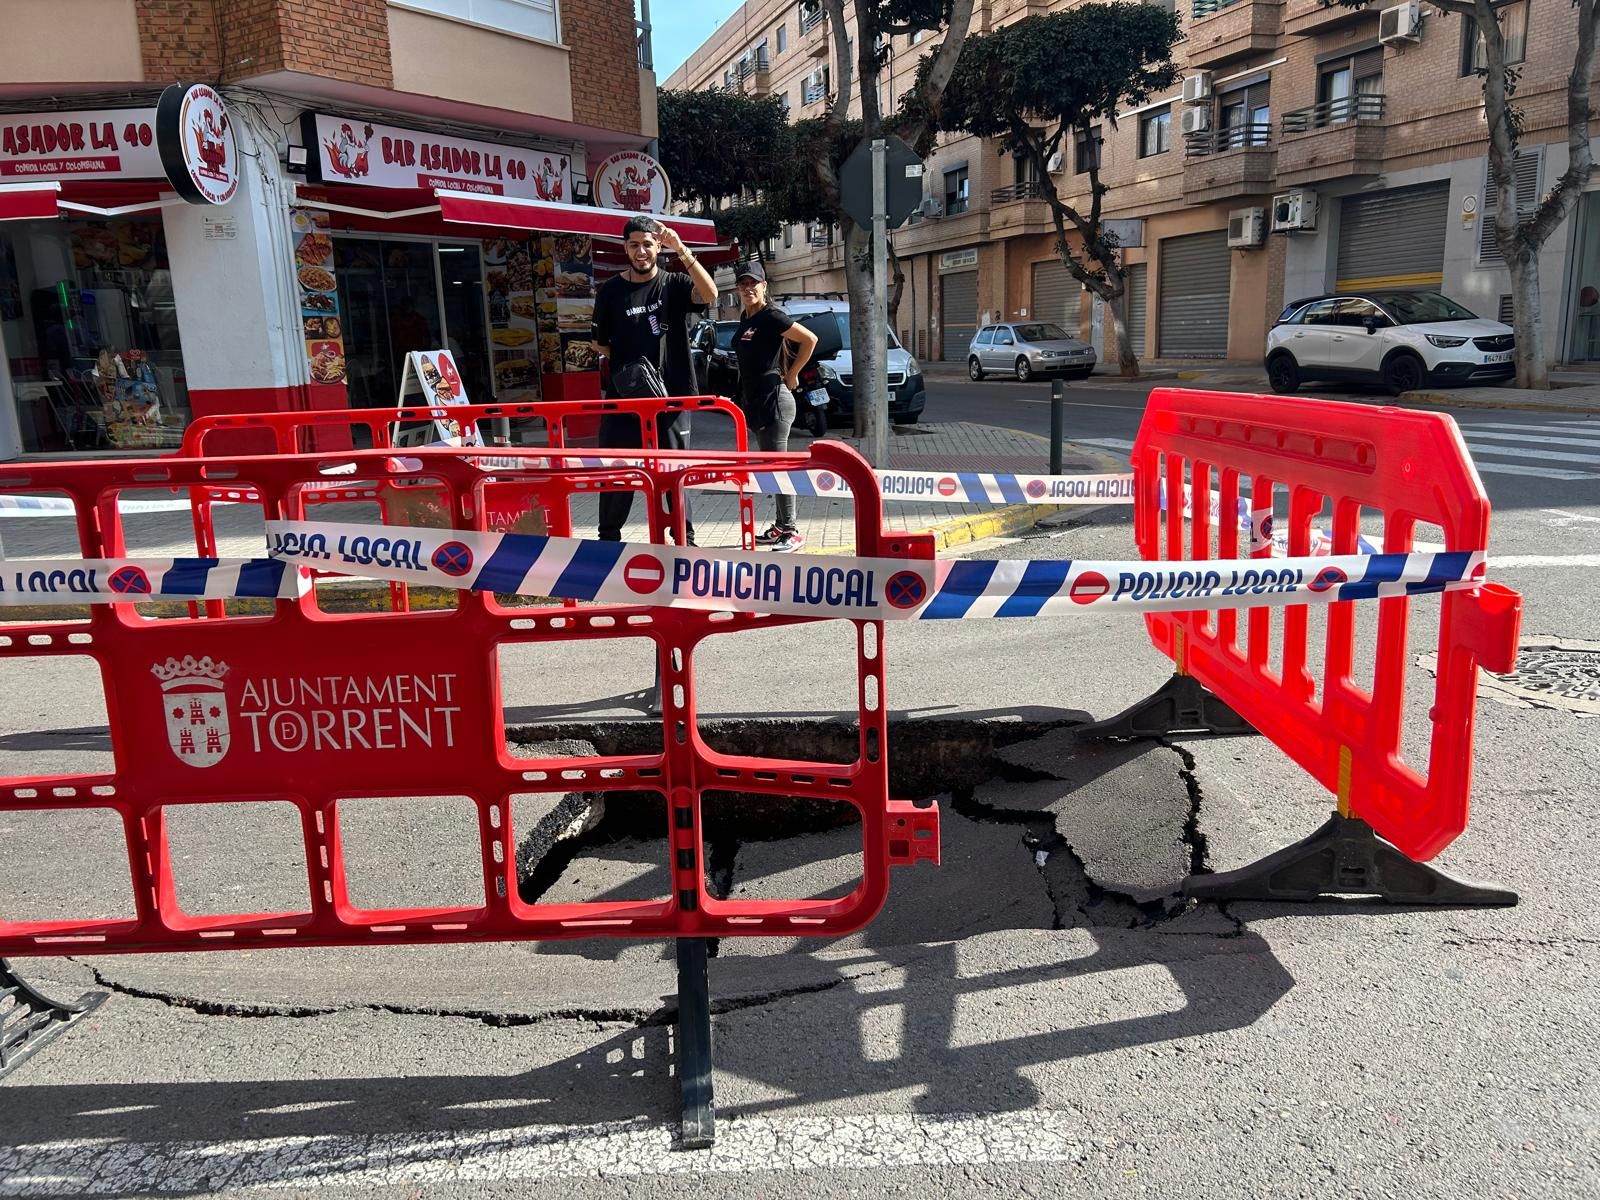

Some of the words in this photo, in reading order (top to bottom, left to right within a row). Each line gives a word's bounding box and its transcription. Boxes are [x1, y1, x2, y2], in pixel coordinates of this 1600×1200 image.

[3, 122, 85, 155] ASADOR
[90, 122, 118, 151] LA
[124, 123, 152, 147] 40
[15, 163, 38, 173] COMIDA
[40, 162, 58, 172] LOCAL
[60, 161, 64, 170] Y
[66, 160, 106, 171] COLOMBIANA
[382, 136, 416, 166] BAR
[420, 144, 481, 176] ASADOR
[484, 152, 503, 180] LA
[506, 159, 526, 180] 40
[448, 181, 461, 190] LOCAL
[338, 536, 428, 571] LOCAL
[672, 558, 782, 602] POLICIA
[792, 566, 878, 607] LOCAL
[1112, 570, 1220, 601] POLICIA
[1222, 568, 1302, 596] LOCAL
[240, 674, 456, 711] AJUNTAMENT
[240, 707, 460, 752] TORRENT
